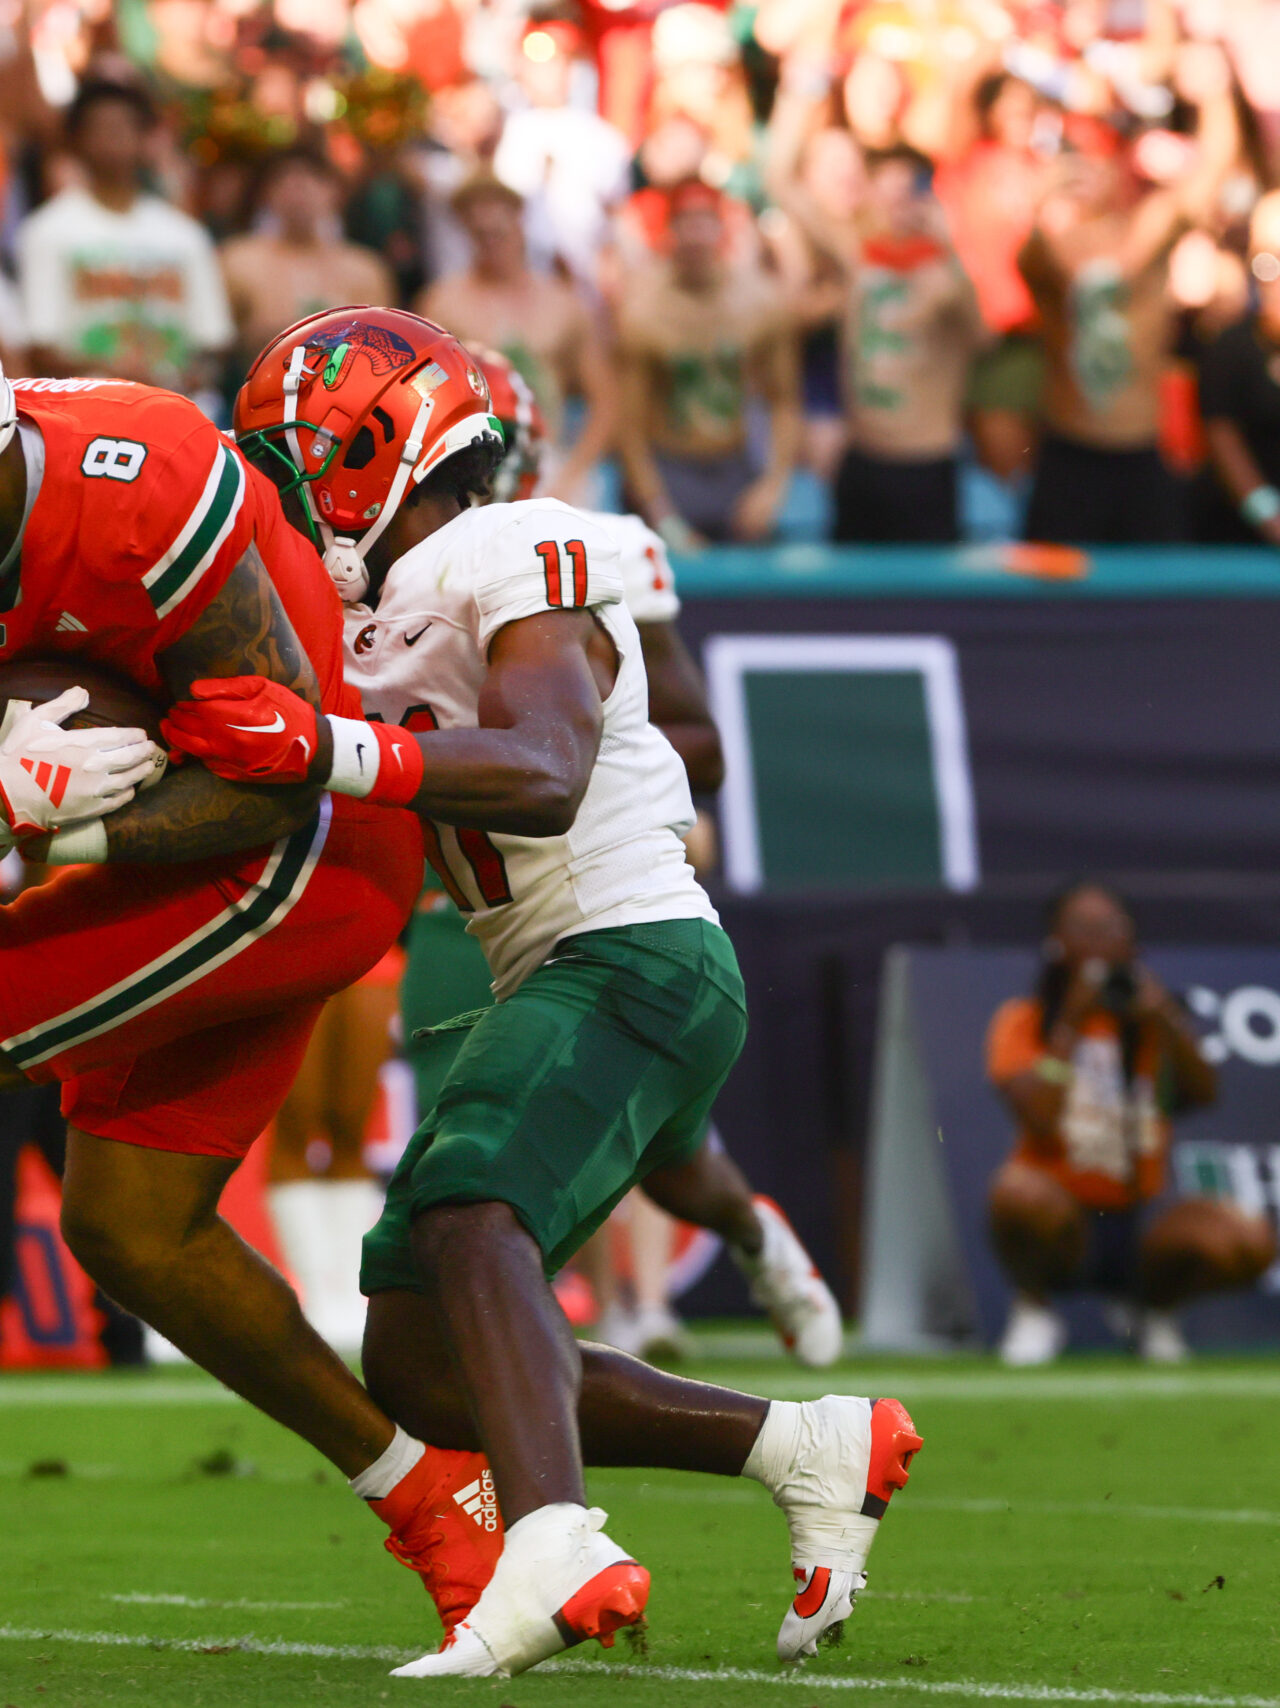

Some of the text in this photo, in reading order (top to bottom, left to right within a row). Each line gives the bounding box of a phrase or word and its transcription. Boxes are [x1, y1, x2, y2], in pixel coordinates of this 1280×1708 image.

[80, 434, 149, 484] 8
[534, 538, 588, 608] 11
[480, 1468, 497, 1532] adidas
